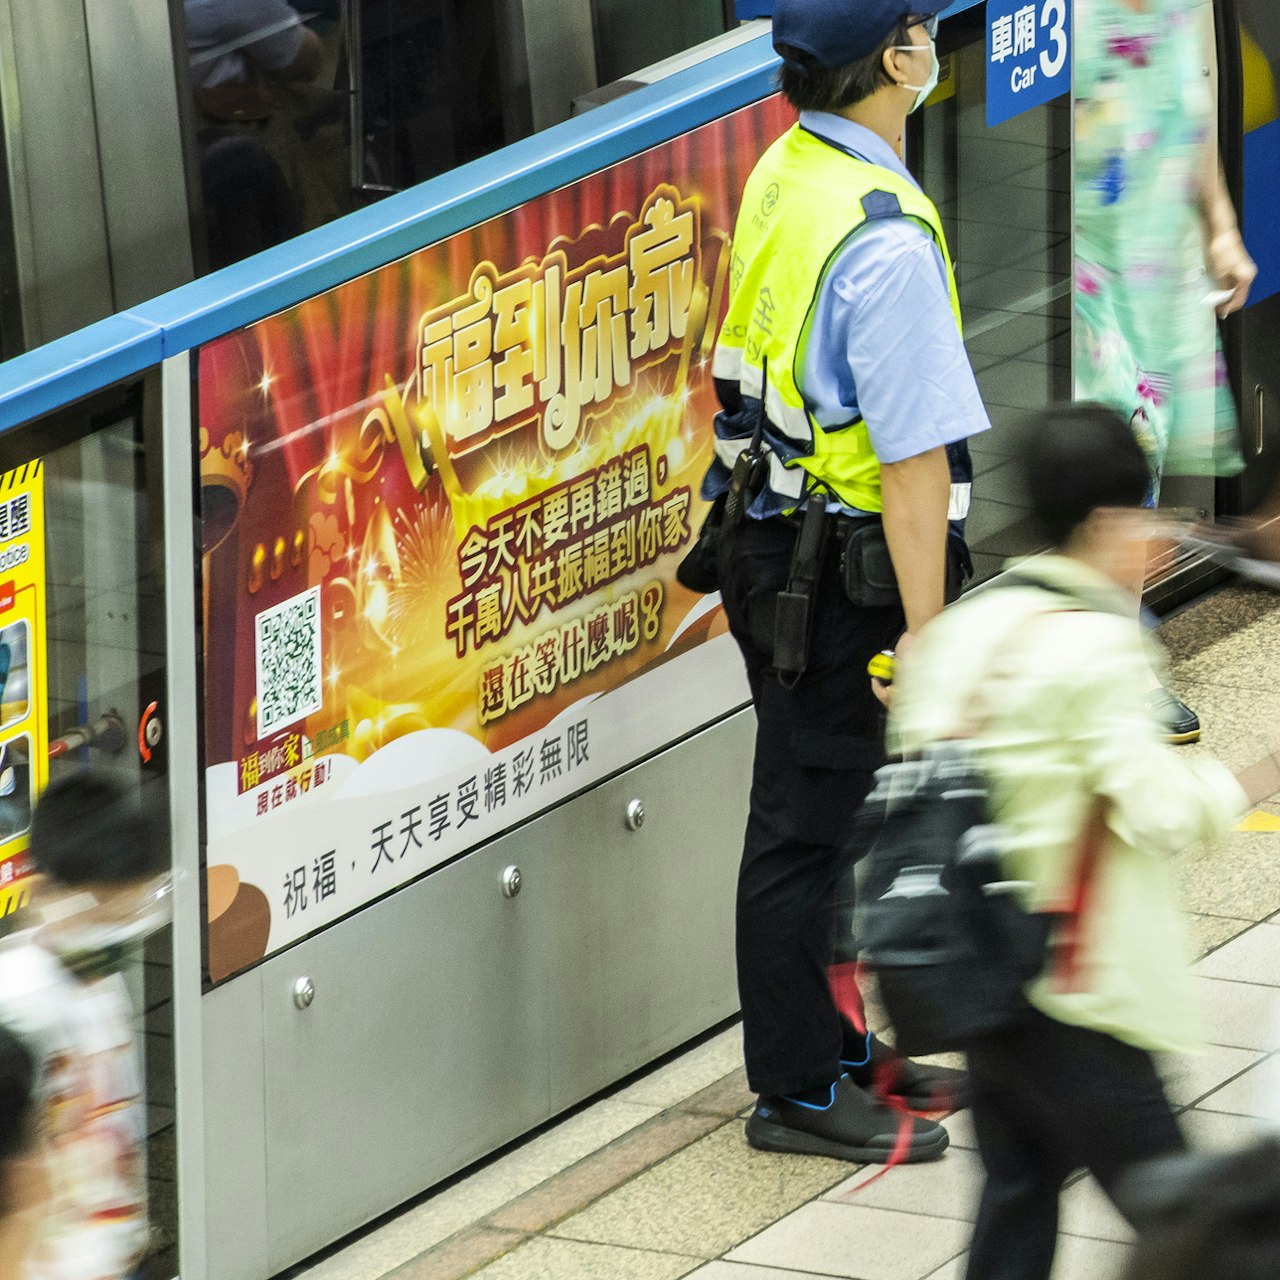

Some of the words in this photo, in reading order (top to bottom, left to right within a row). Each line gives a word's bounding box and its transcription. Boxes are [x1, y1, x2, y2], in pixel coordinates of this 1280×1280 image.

[991, 4, 1036, 63] 車廂
[1011, 64, 1037, 93] Car
[423, 197, 694, 449] 福到你家
[448, 492, 690, 653] 千萬人共振福到你家
[241, 733, 300, 791] 福到你家
